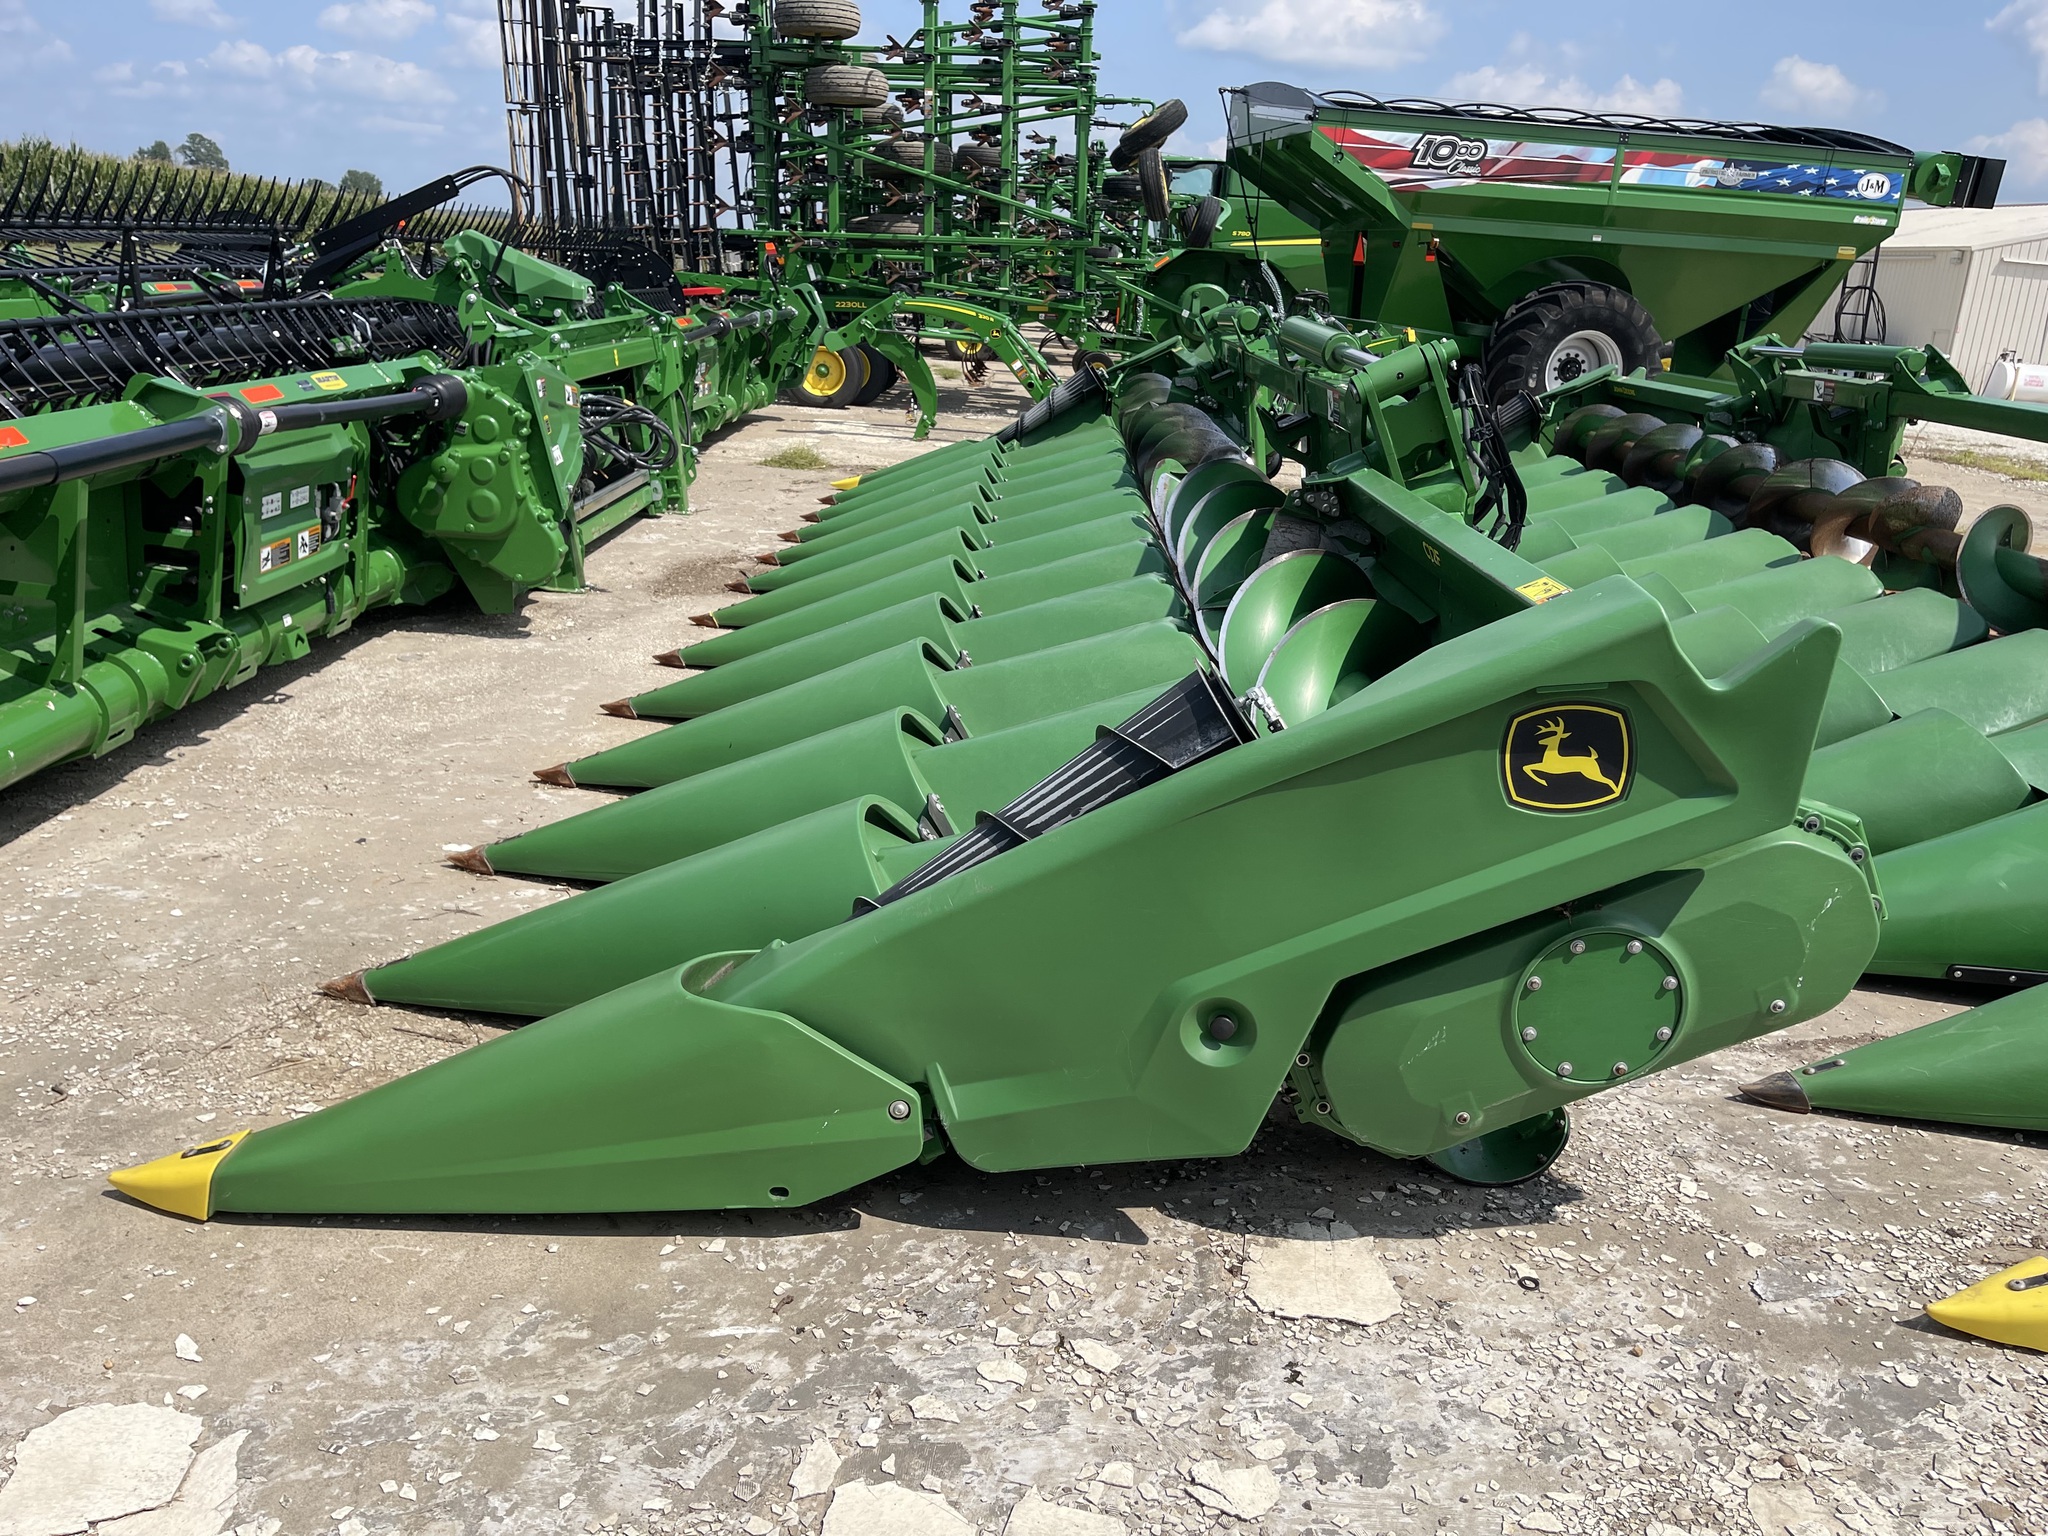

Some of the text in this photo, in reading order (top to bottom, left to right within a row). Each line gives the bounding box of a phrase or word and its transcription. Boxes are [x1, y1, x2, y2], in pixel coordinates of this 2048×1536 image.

[1414, 134, 1485, 166] 1000
[1860, 178, 1885, 194] J&M
[835, 301, 868, 309] 2230LL
